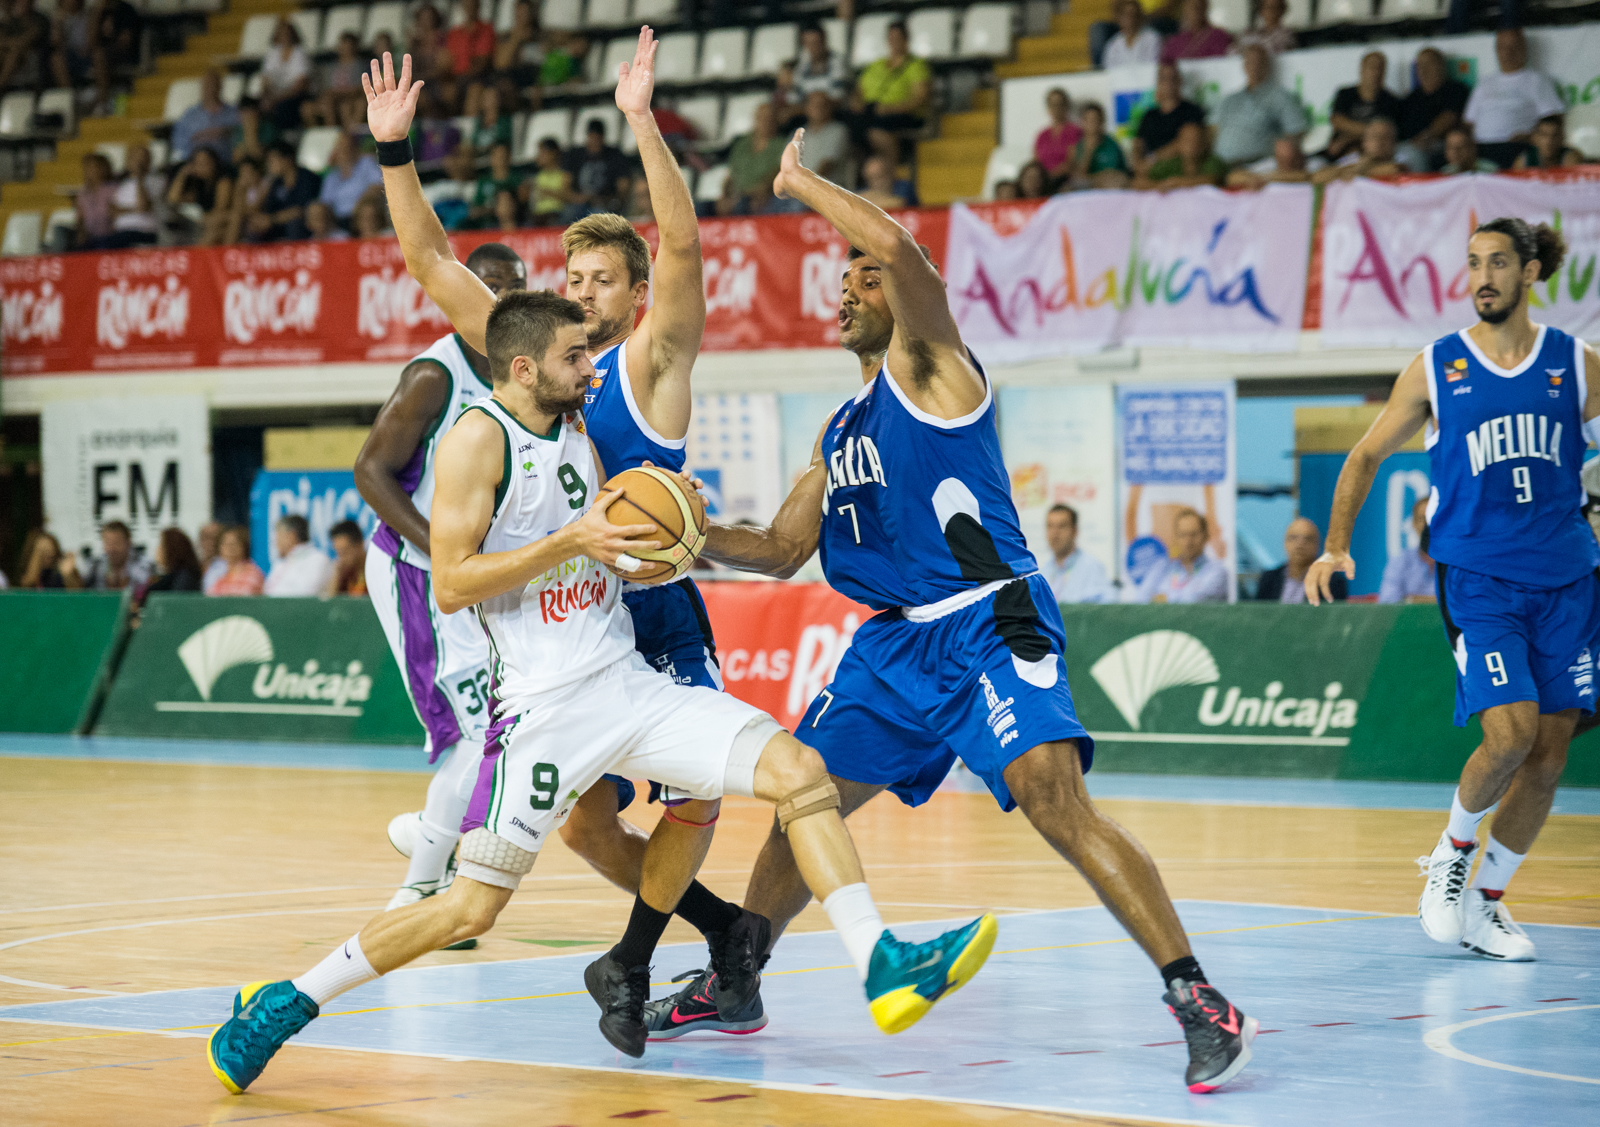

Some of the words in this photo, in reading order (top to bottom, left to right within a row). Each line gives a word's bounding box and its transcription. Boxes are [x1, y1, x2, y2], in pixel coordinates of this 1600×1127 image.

[954, 216, 1281, 337] Andalucía
[1465, 413, 1563, 477] MELILLA
[92, 460, 180, 521] FM
[556, 462, 588, 510] 9
[1512, 466, 1533, 504] 9
[836, 503, 862, 546] 7
[252, 658, 373, 708] Unicaja
[1484, 651, 1509, 687] 9
[810, 688, 834, 729] 7
[1198, 678, 1358, 738] Unicaja
[530, 762, 559, 811] 9
[509, 816, 541, 840] SPALDING
